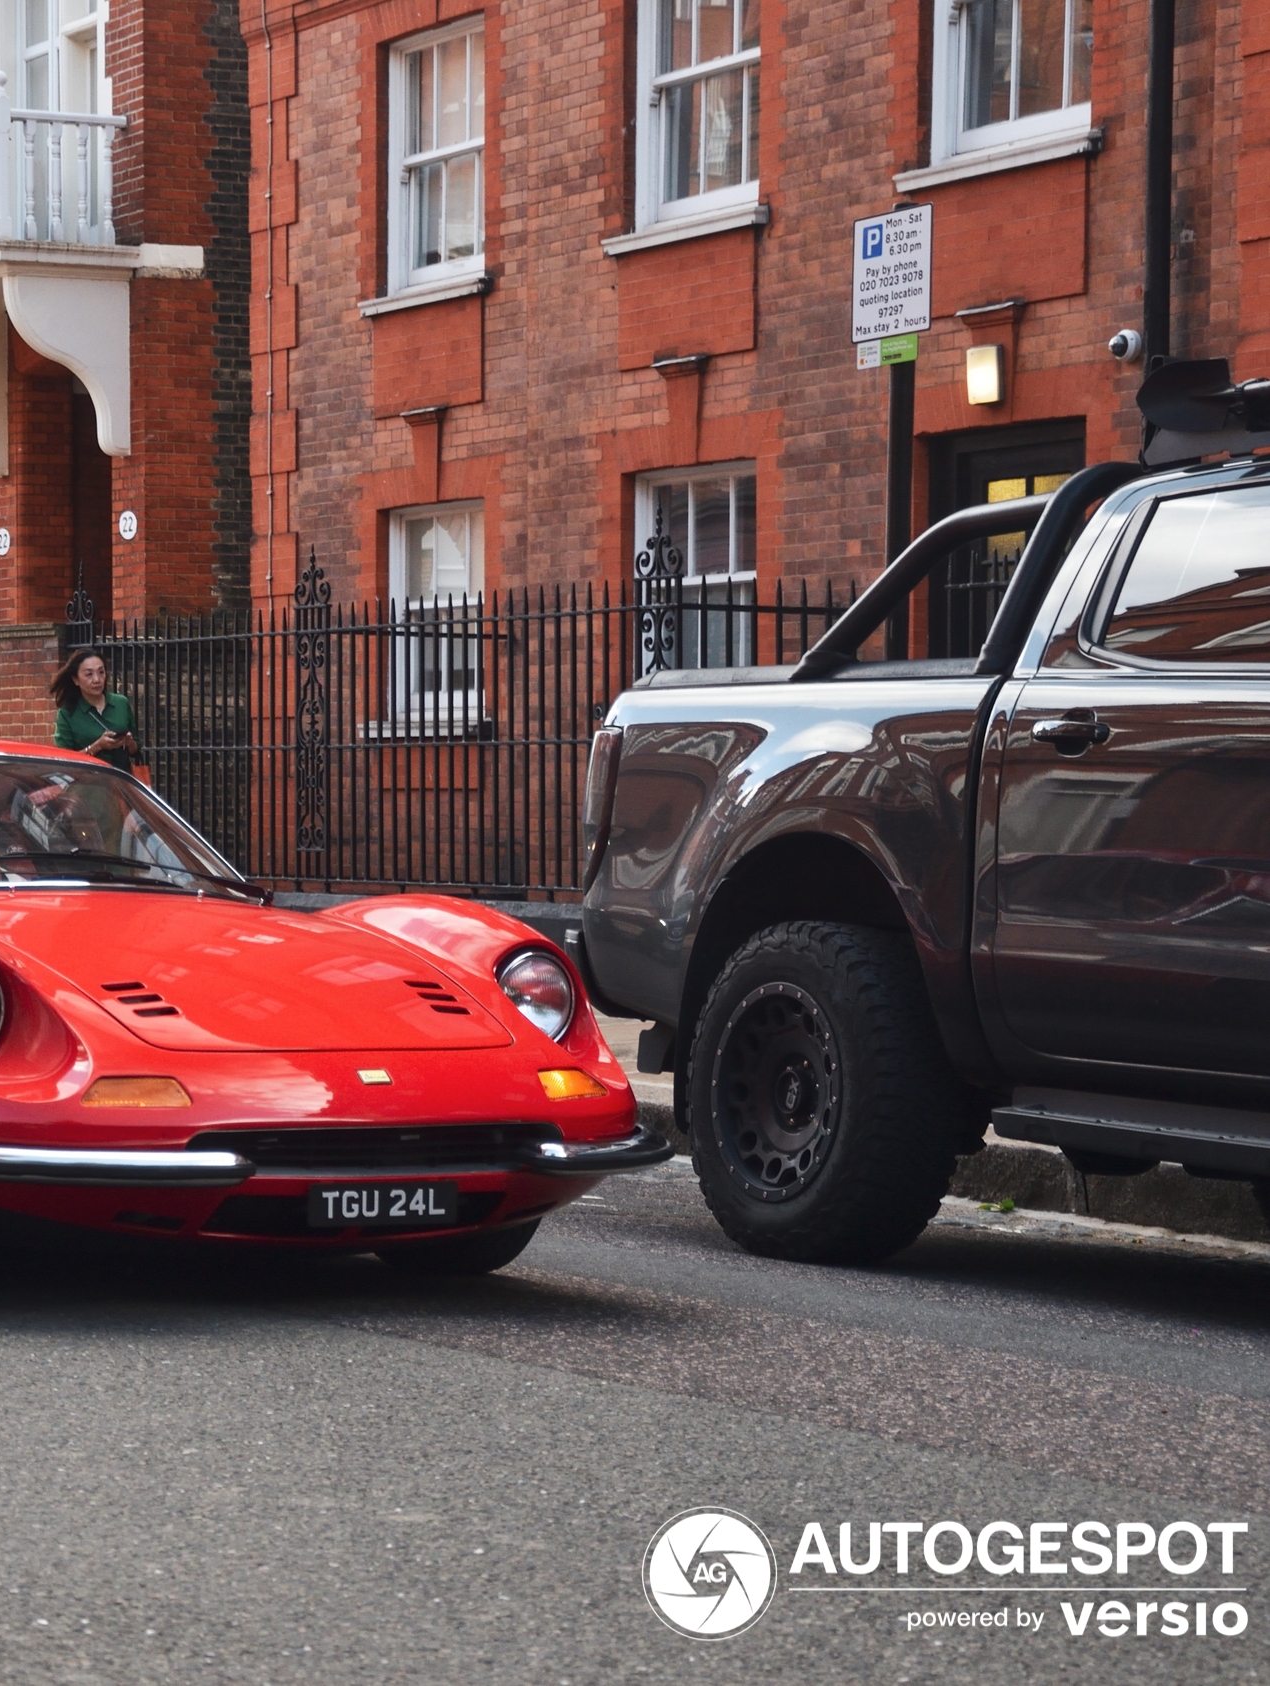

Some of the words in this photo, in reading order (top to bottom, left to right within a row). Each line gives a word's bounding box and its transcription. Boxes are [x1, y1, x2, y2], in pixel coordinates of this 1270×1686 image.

[886, 219, 902, 229] Mon
[909, 212, 922, 224] Sat
[866, 228, 880, 256] P
[885, 230, 904, 244] 8.30
[906, 230, 917, 239] am
[890, 243, 908, 256] 6.30
[910, 242, 922, 253] pm
[866, 268, 880, 278] Pay
[882, 265, 891, 275] by
[894, 260, 918, 274] phone
[860, 280, 876, 292] 020
[879, 275, 899, 288] 7023
[902, 270, 923, 283] 9078
[860, 294, 889, 308] quoting
[891, 287, 923, 300] location
[878, 304, 903, 318] 97297
[856, 326, 871, 336] Max
[874, 323, 890, 333] stay
[894, 319, 899, 329] 2
[904, 316, 926, 327] hours
[123, 516, 134, 533] 22
[322, 1190, 379, 1219] TGU
[389, 1188, 445, 1217] 24L
